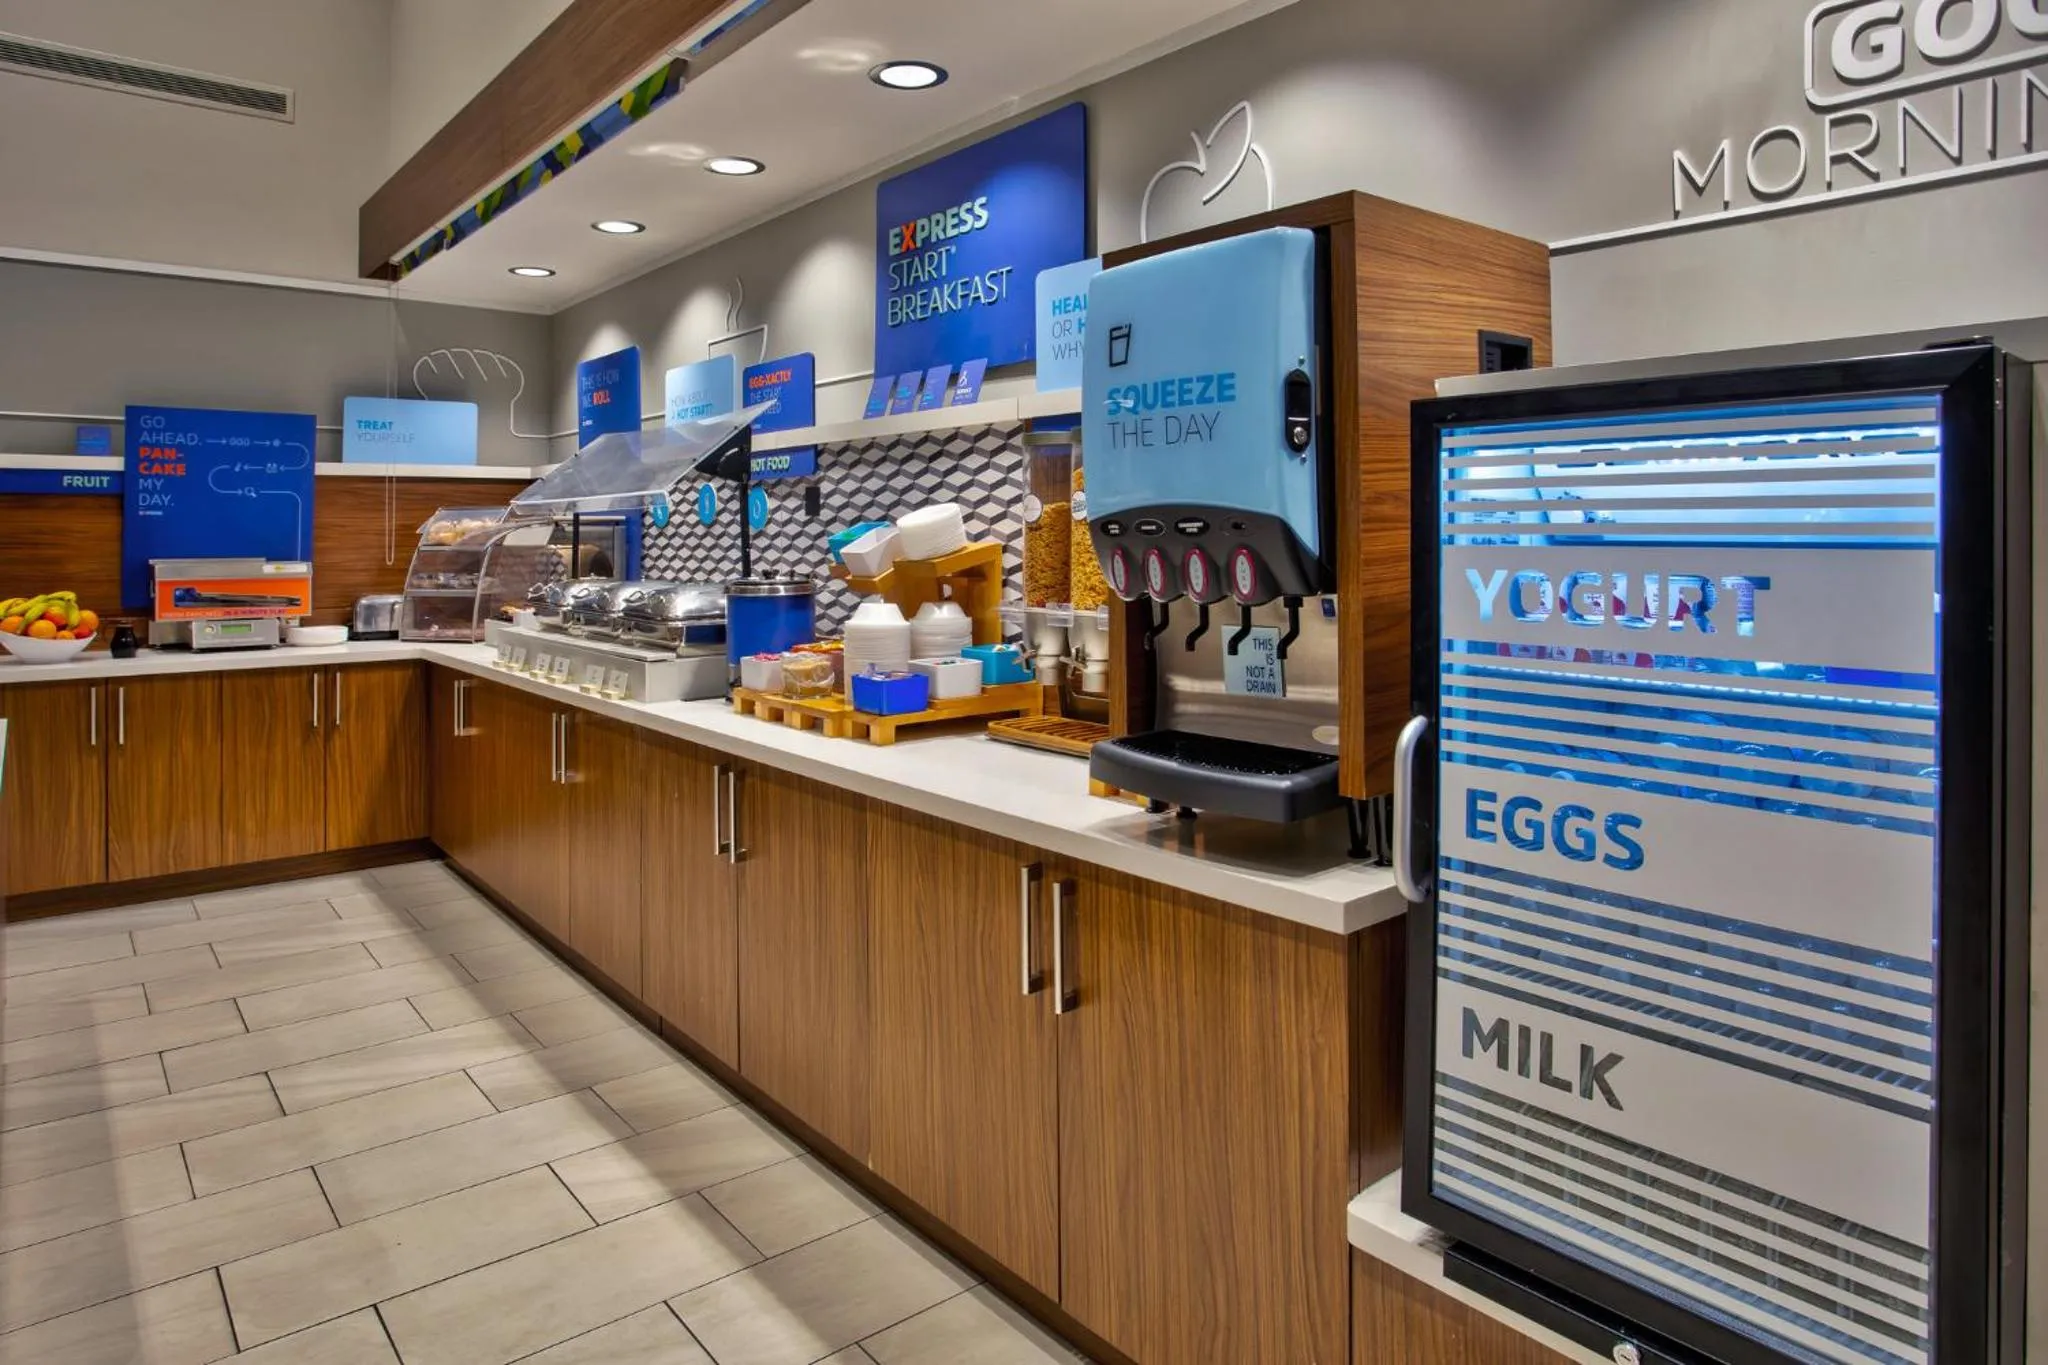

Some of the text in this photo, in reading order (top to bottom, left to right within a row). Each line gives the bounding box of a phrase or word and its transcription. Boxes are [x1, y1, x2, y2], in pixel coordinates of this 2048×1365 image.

[888, 196, 988, 256] EXPRESS
[887, 265, 1013, 327] BREAKFAST
[1051, 320, 1073, 339] OR
[749, 370, 792, 389] EGG-XACTLY
[1106, 372, 1238, 416] SQUEEZE
[140, 415, 165, 429] GO
[356, 419, 394, 431] TREAT
[356, 431, 416, 444] YOURSELF
[1107, 411, 1222, 449] THE DAY
[139, 430, 203, 446] AHEAD.
[139, 447, 185, 460] PAN-
[138, 461, 186, 476] CAKE
[751, 455, 791, 473] HOT FOOD
[62, 475, 110, 488] FRUIT
[139, 478, 165, 491] MY
[138, 493, 176, 507] DAY.
[1465, 568, 1771, 637] YOGURT
[1252, 638, 1274, 651] THIS
[1265, 653, 1275, 666] IS
[1246, 665, 1275, 680] NOT A
[1246, 680, 1276, 694] DRAIN
[1465, 788, 1645, 871] EGGS
[1461, 1006, 1625, 1112] MILK
